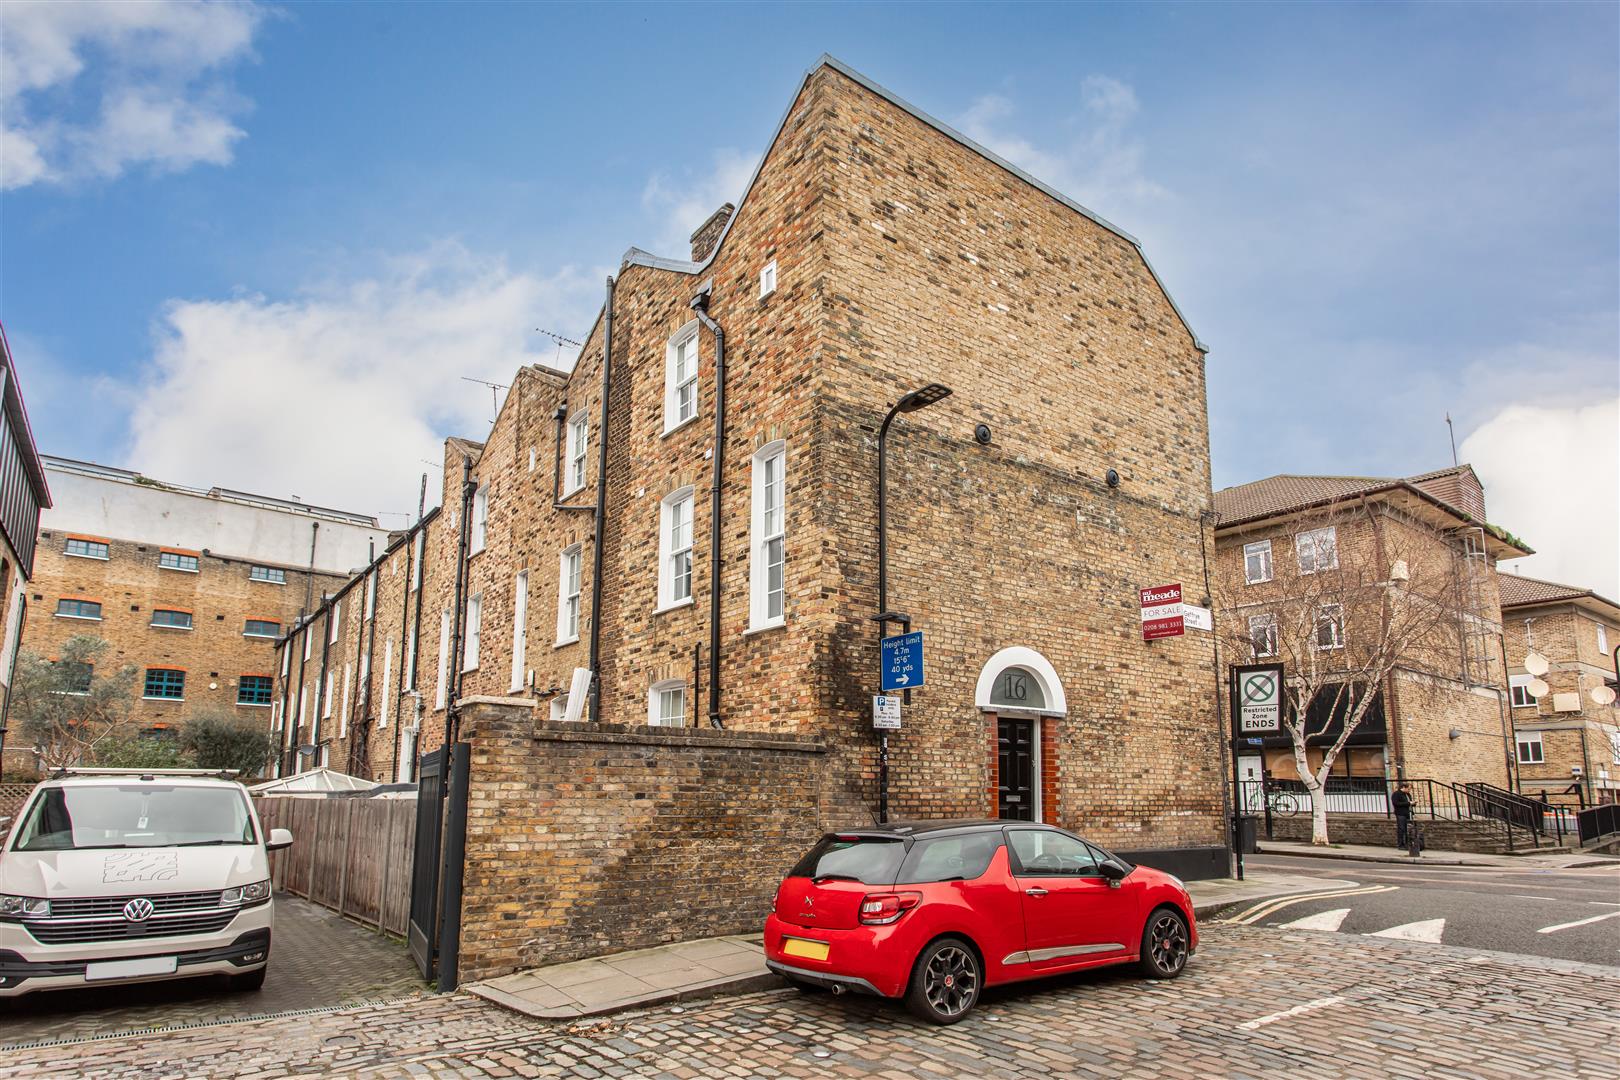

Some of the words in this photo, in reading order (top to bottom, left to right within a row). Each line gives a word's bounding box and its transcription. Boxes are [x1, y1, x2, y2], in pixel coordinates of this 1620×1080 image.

[1143, 590, 1180, 601] meade
[1144, 609, 1161, 617] FOR
[1162, 605, 1181, 615] SALE
[883, 639, 904, 649] Height
[905, 635, 921, 645] limit
[891, 665, 901, 673] 40
[902, 664, 914, 674] yds
[1006, 674, 1025, 699] 16
[1245, 720, 1275, 728] ENDS
